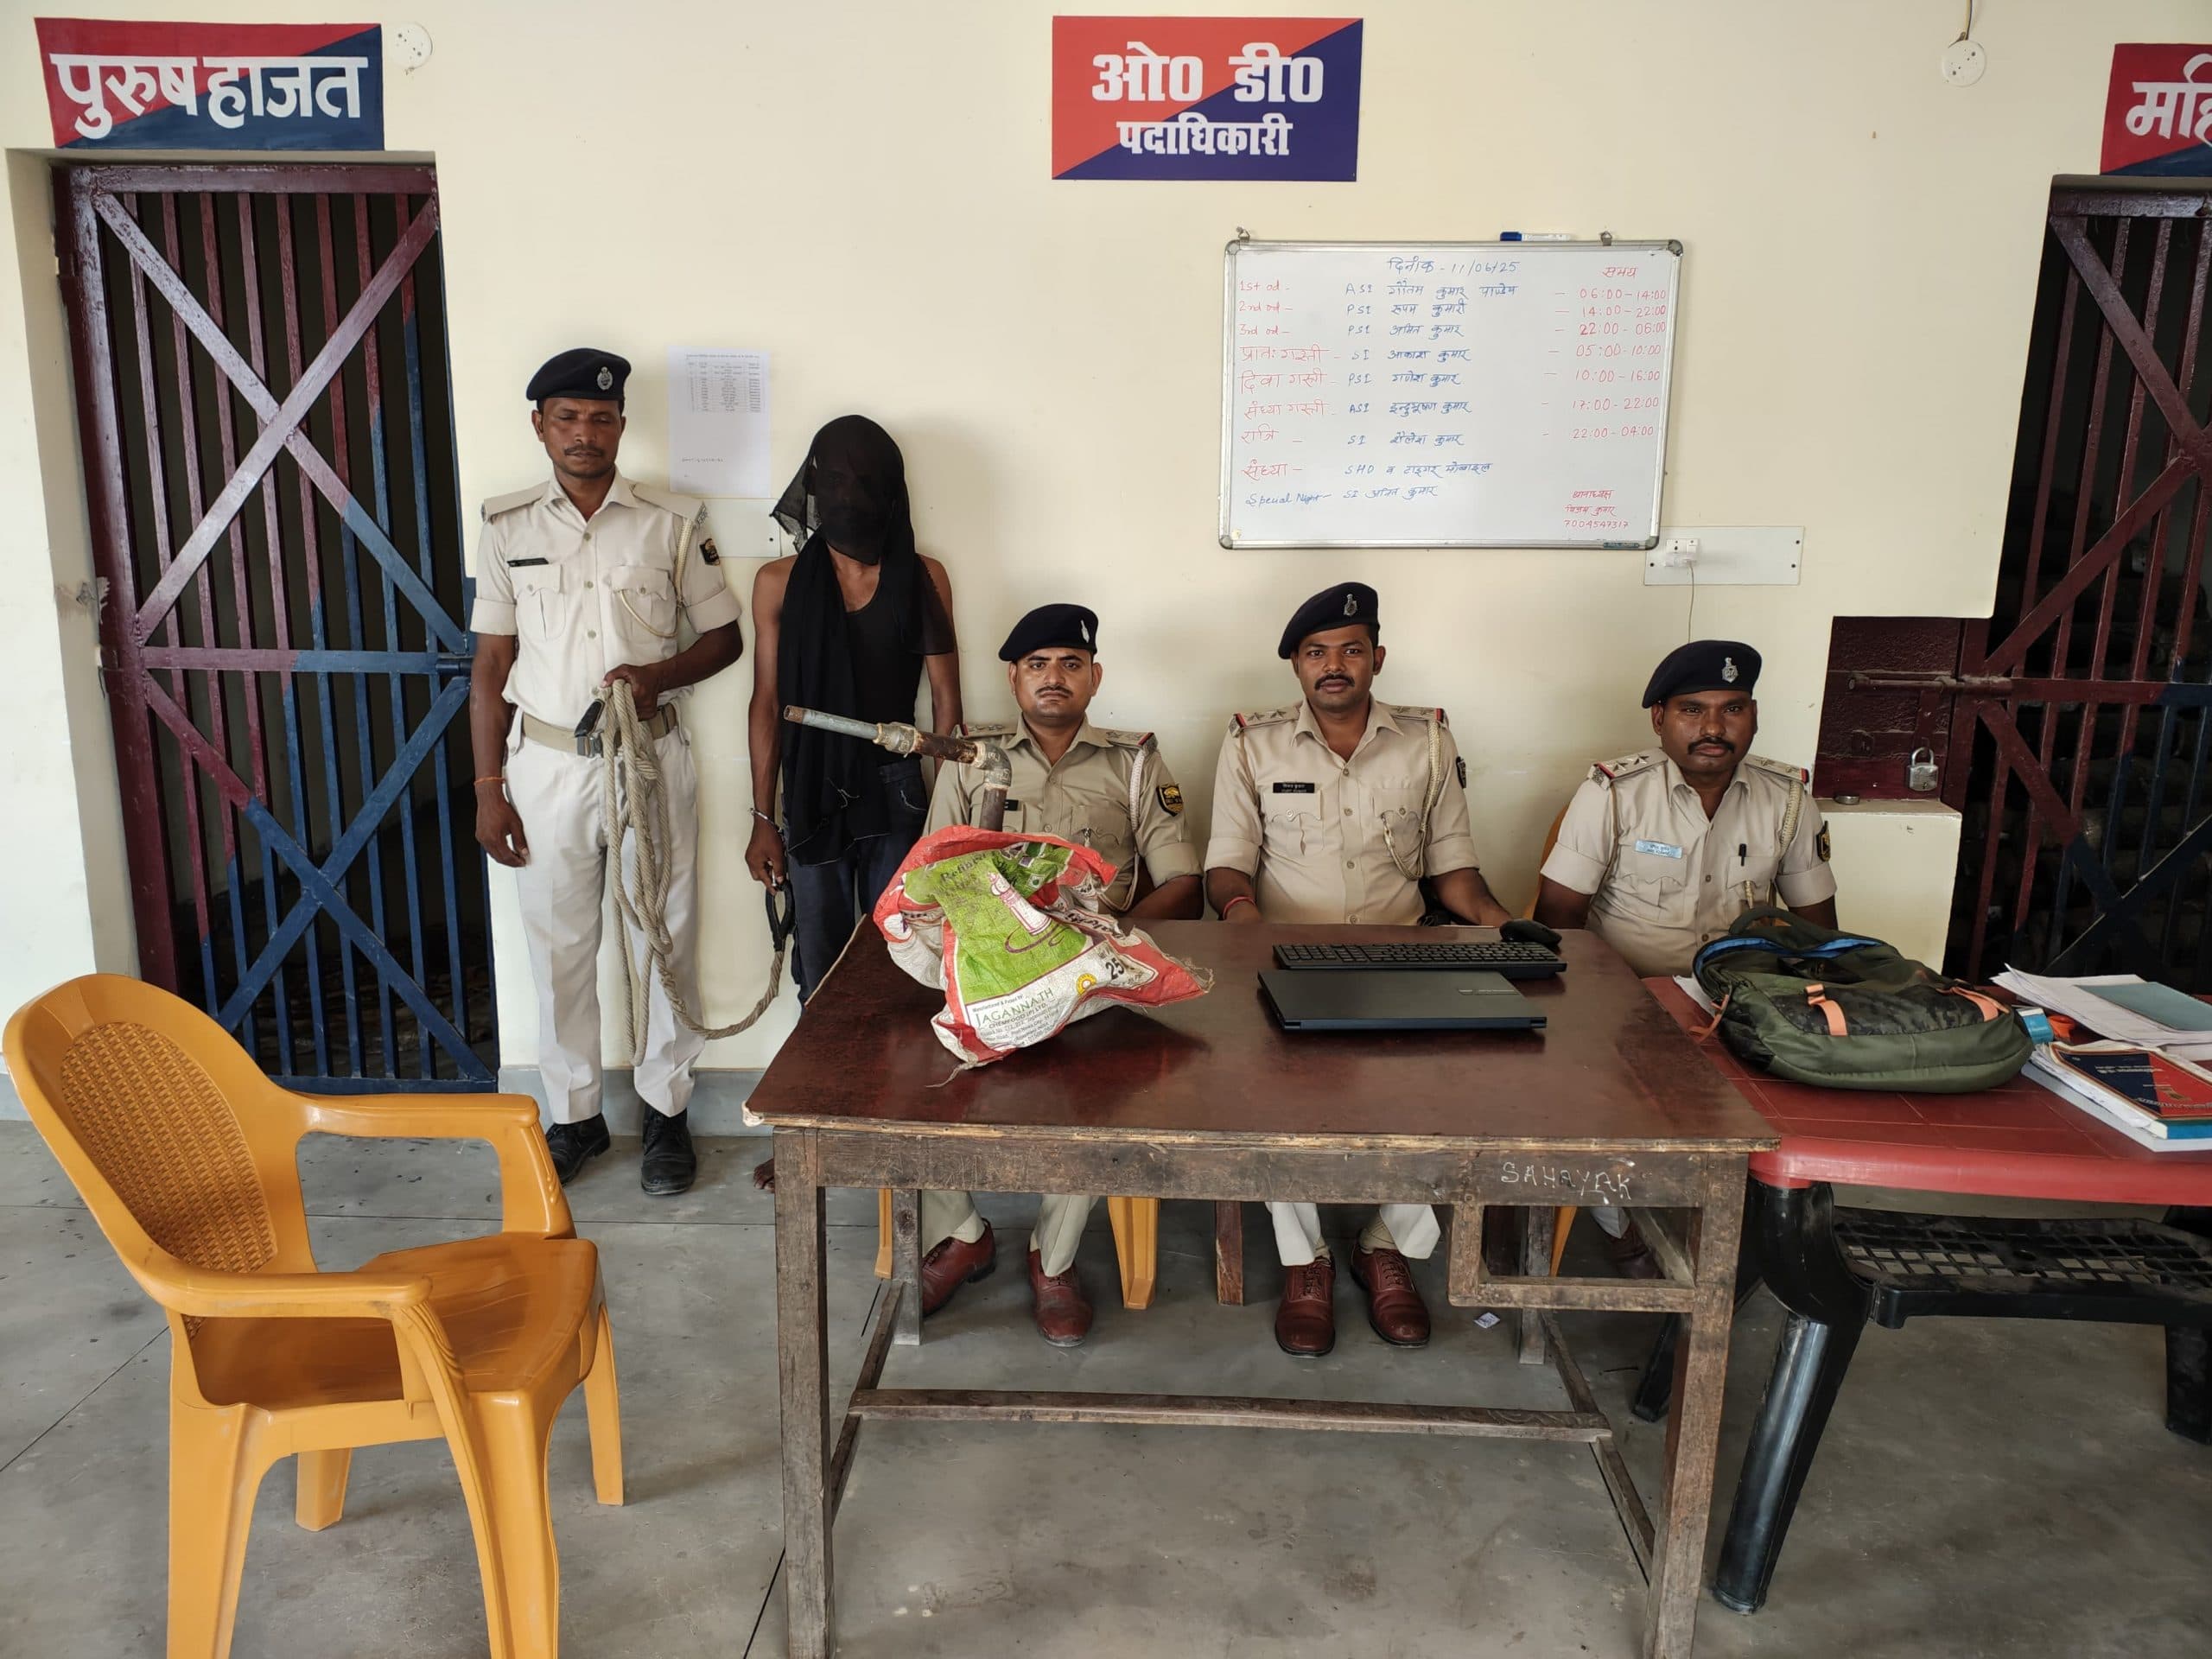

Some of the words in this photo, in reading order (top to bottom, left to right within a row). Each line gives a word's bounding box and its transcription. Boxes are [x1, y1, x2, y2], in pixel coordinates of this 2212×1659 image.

[48, 53, 198, 140] पुरुष
[202, 56, 369, 130] हाजत
[1116, 112, 1294, 156] पदाधिकारी
[1602, 267, 1638, 277] समय
[1239, 280, 1261, 291] 1st
[1435, 287, 1469, 300] कुमार
[1346, 304, 1371, 315] PSI
[1431, 298, 1467, 317] कुमारी
[1348, 325, 1370, 336] PSI
[1428, 324, 1465, 340] कुमार
[1351, 349, 1370, 359] SI
[1437, 348, 1471, 362] कुमार
[1348, 372, 1372, 386] PSI
[1429, 373, 1461, 387] कुमार
[1349, 403, 1370, 414] ASI
[1440, 401, 1472, 414] कुमार
[1347, 435, 1367, 445] SI
[1433, 434, 1465, 447] कुमार
[1402, 486, 1438, 499] कुमार
[975, 988, 1054, 1027] JAGANNATH
[1500, 1161, 1632, 1200] SAHAYAK
